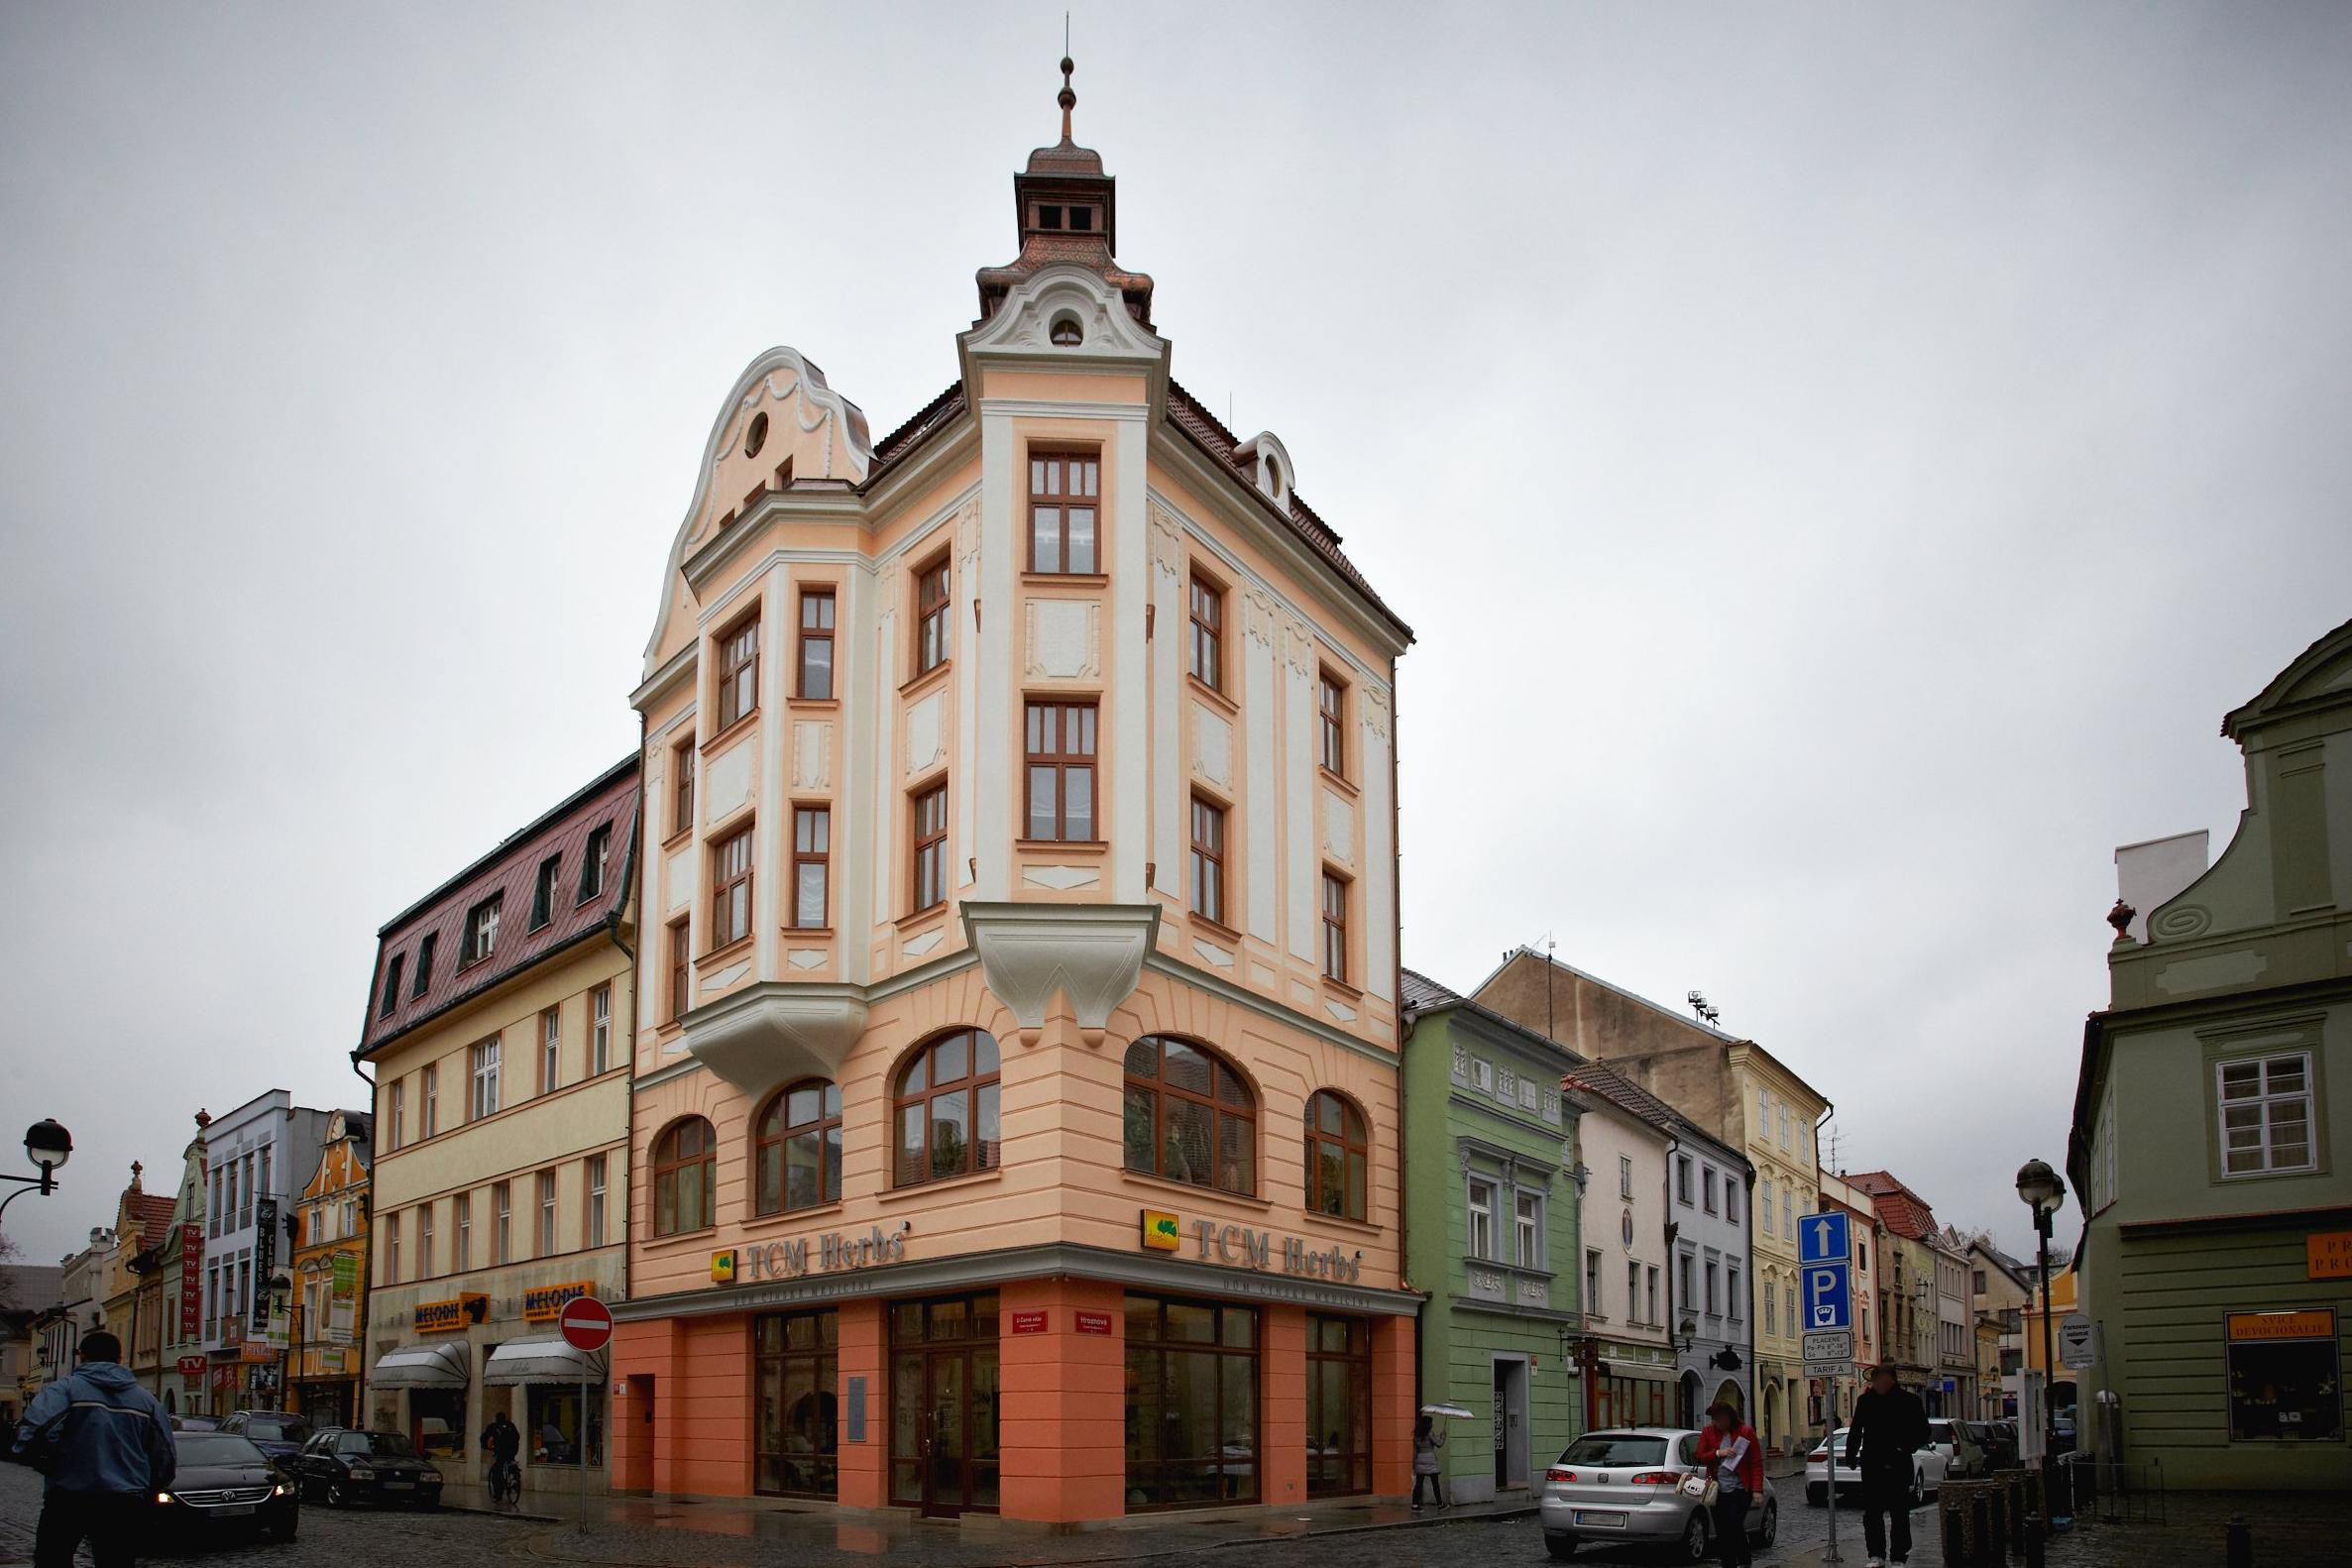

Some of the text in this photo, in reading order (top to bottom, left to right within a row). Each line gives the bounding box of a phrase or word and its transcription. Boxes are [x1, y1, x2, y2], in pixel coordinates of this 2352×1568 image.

[267, 1234, 276, 1279] CLUB
[746, 1225, 906, 1281] TCM Herbs
[1194, 1219, 1362, 1283] TCM Herbs
[1813, 1270, 1837, 1306] P
[415, 1302, 460, 1323] MELODIE
[1080, 1316, 1108, 1326] Hroznová
[181, 1358, 203, 1369] TV
